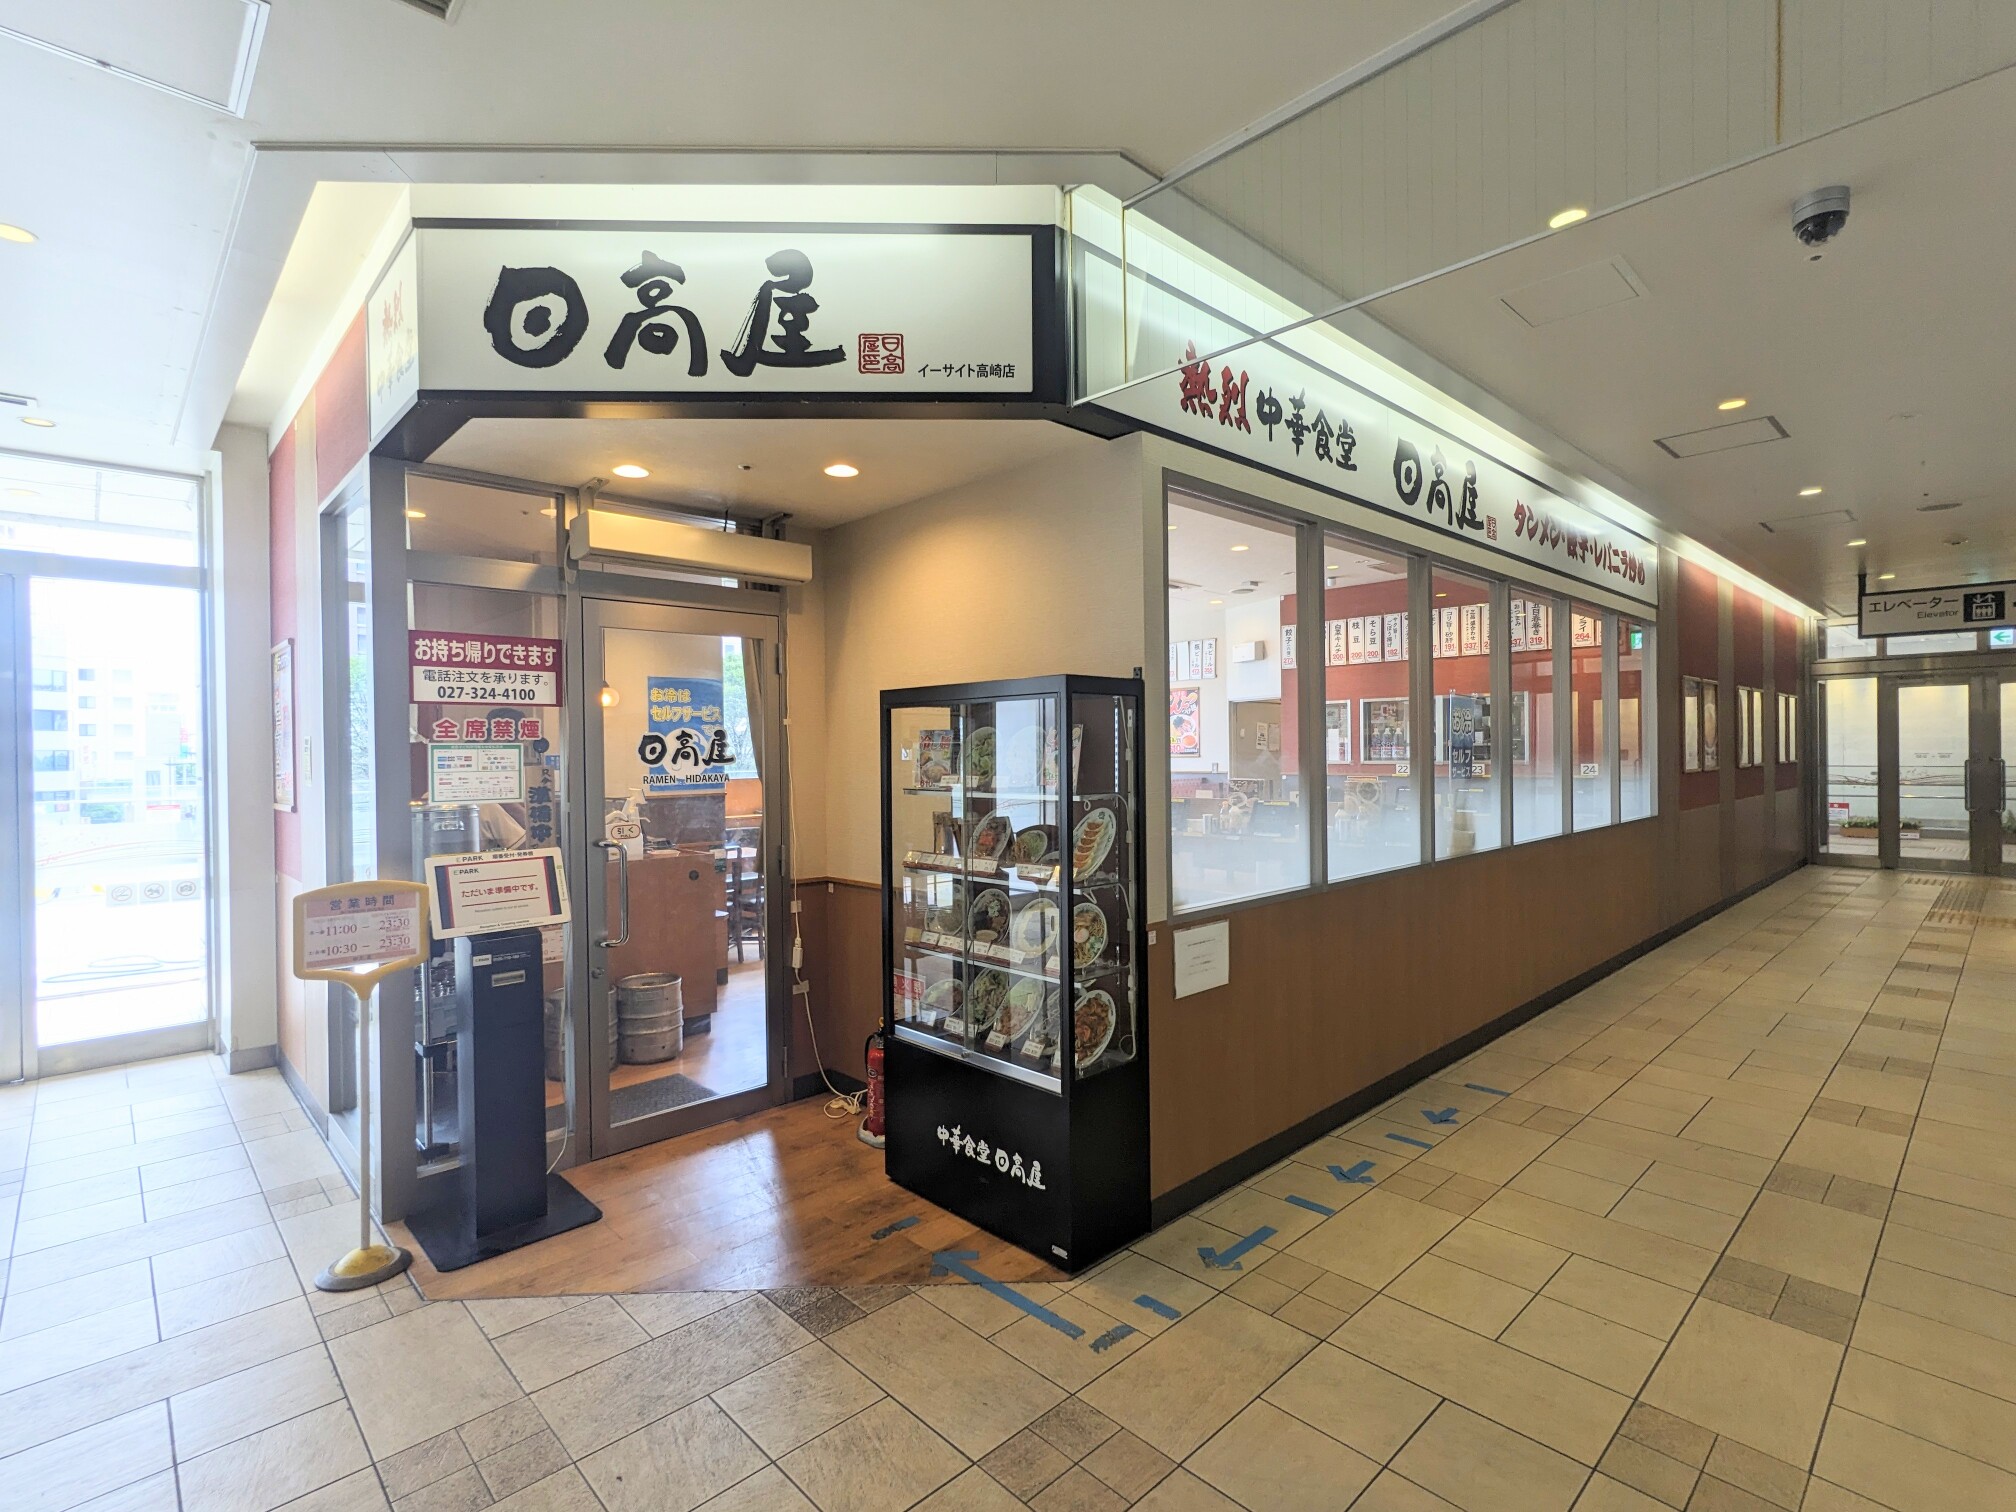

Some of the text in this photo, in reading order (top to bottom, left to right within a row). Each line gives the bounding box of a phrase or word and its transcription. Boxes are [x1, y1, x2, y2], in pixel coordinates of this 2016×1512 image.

[483, 248, 847, 378] 日高屋
[917, 363, 1016, 379] イーサイト高崎店
[1256, 386, 1357, 471] 中華食堂
[1393, 435, 1484, 531] 日高屋
[1868, 597, 1960, 613] エレベーター
[1916, 609, 1960, 619] Elevator
[1368, 620, 1377, 645] そら豆
[1529, 636, 1543, 644] 319
[1574, 633, 1590, 641] 264
[415, 638, 556, 666] お持ち帰りできます
[422, 669, 548, 686] 電話注文を承ります。
[437, 686, 536, 700] 027-324-4100
[650, 706, 722, 722] セルフサービス
[434, 719, 541, 739] 全席禁煙
[638, 730, 735, 767] 日高屋
[1472, 766, 1483, 774] 23
[1583, 765, 1596, 774] 24
[643, 773, 730, 784] RAMEN HIDAKAYA
[329, 895, 395, 910] 営業時間
[326, 924, 357, 936] 11:00
[327, 943, 357, 956] 10:30
[937, 1124, 1046, 1190] 中華食堂 日高屋
